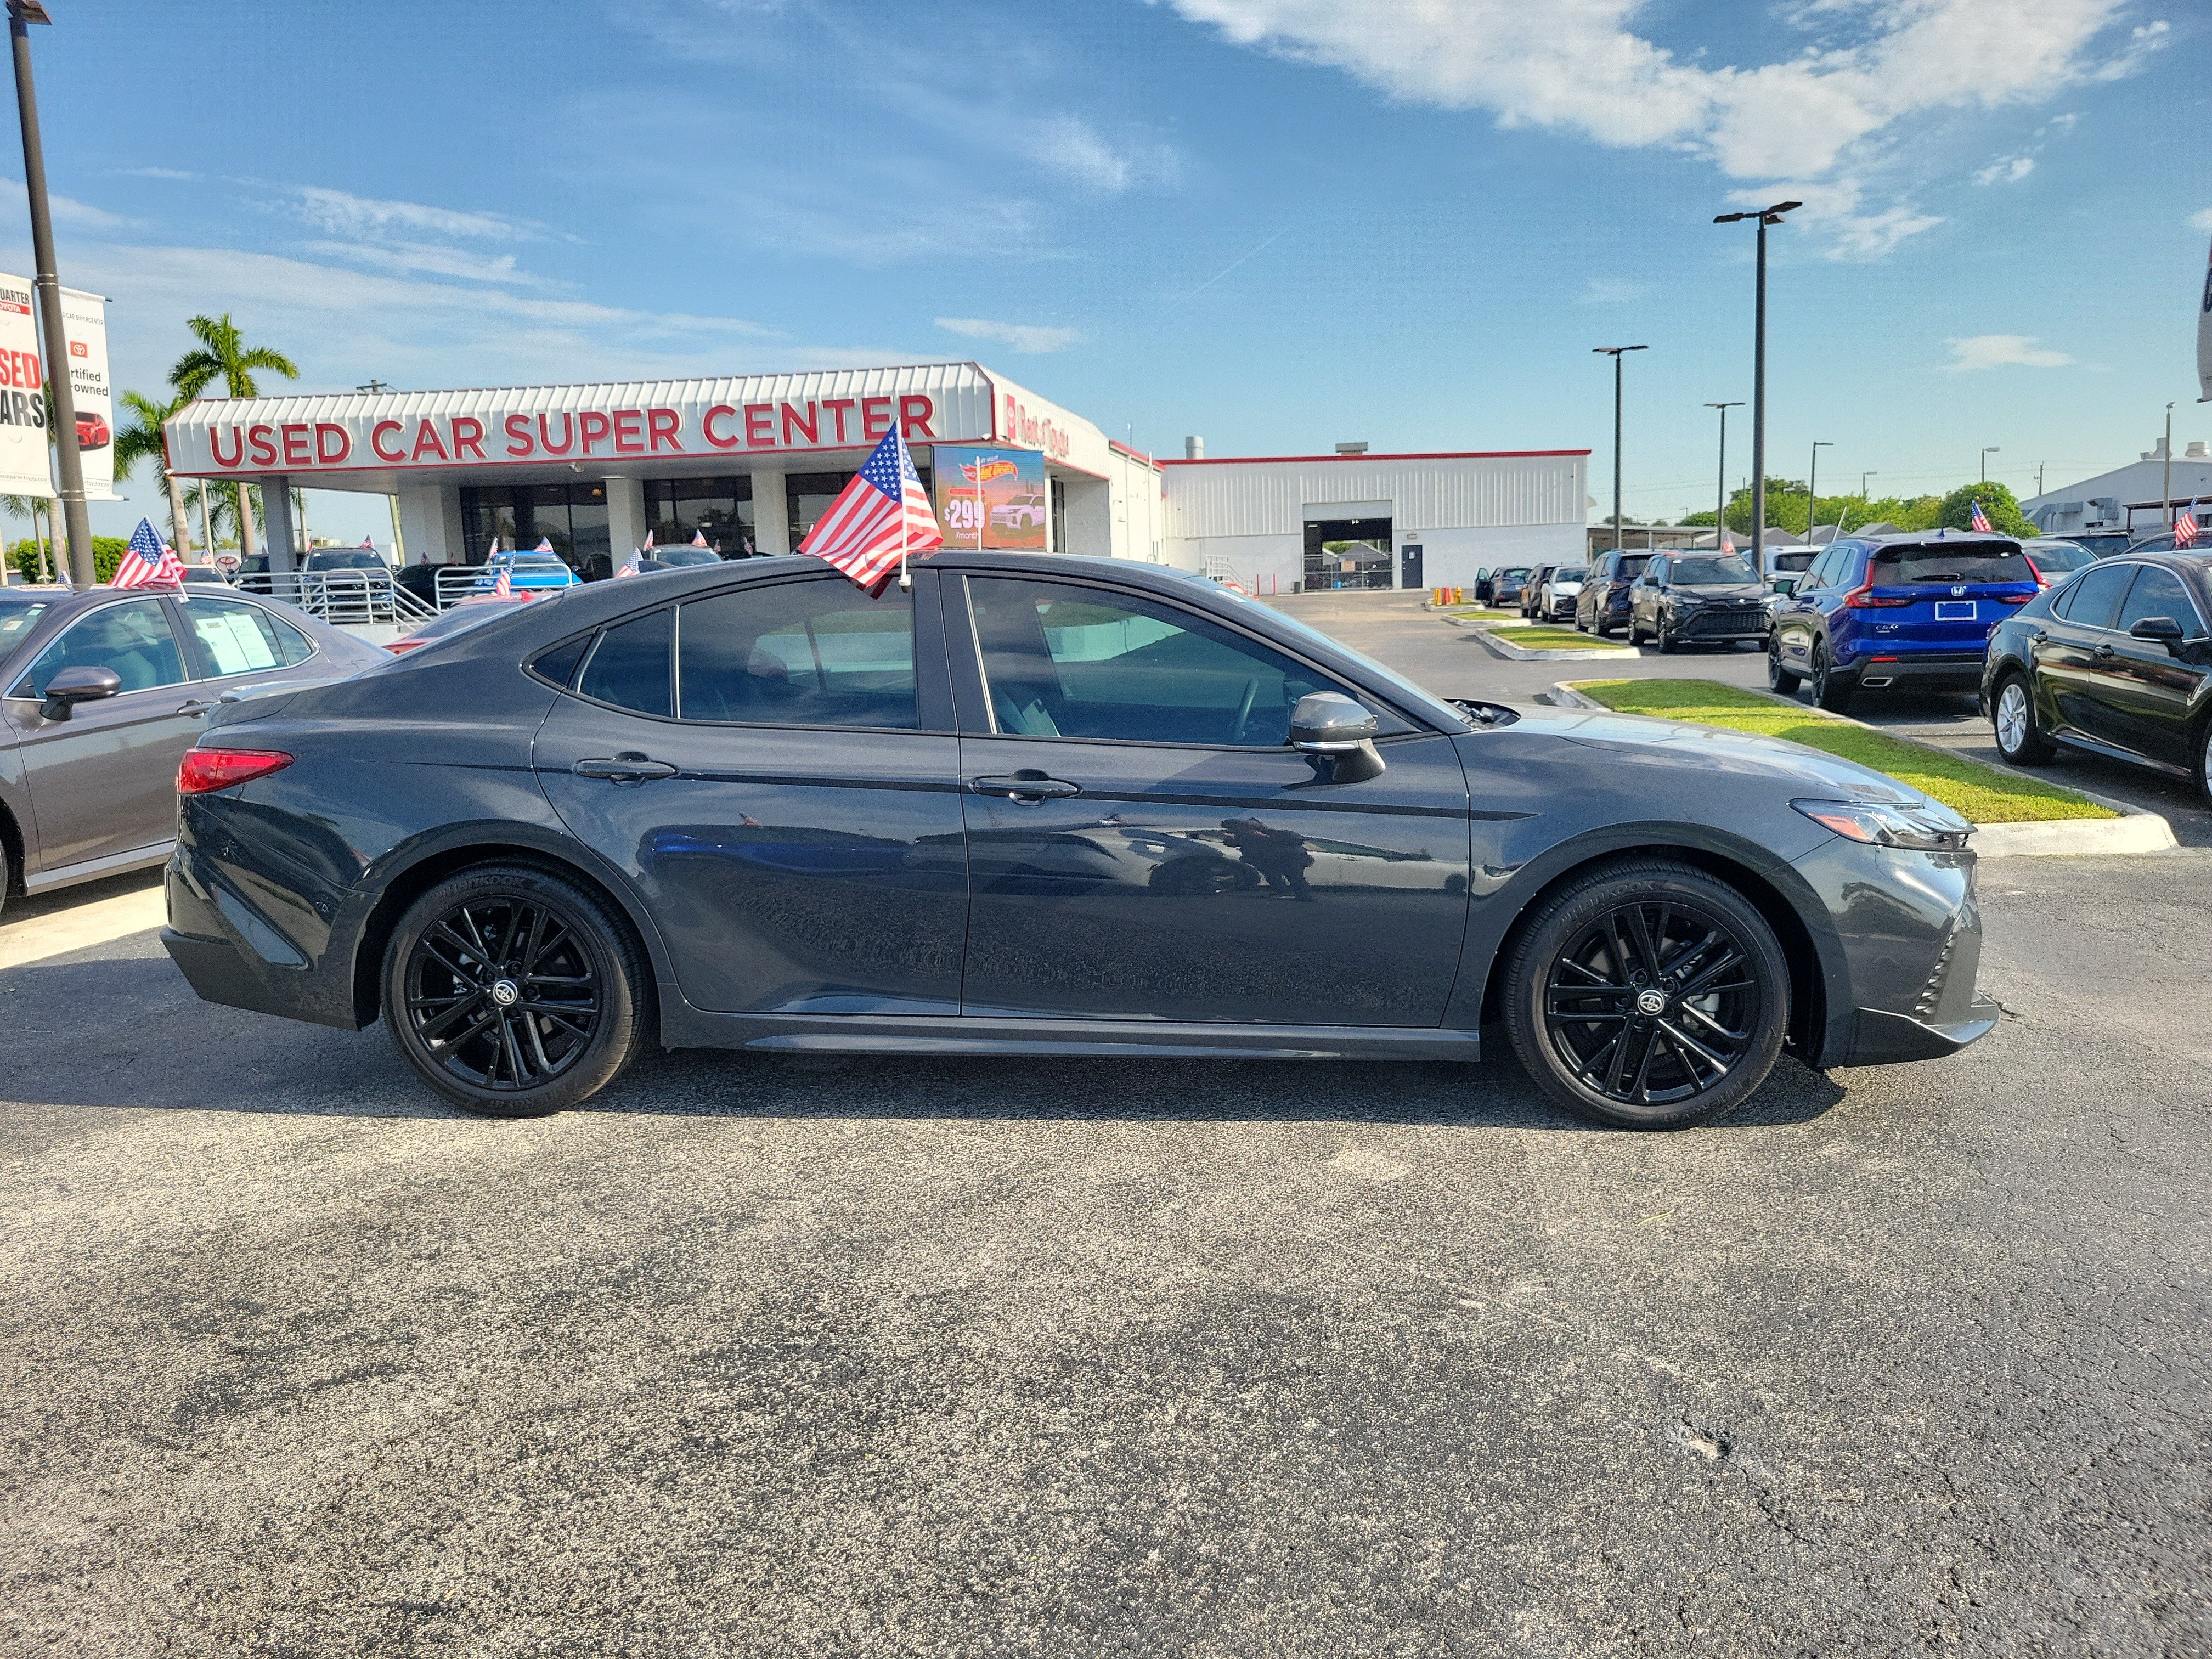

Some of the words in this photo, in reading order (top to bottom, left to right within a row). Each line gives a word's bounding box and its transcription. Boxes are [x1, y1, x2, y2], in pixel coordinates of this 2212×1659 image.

[210, 423, 353, 468] USED
[371, 417, 489, 462] CAR
[504, 408, 685, 457] SUPER
[702, 394, 939, 449] CENTER
